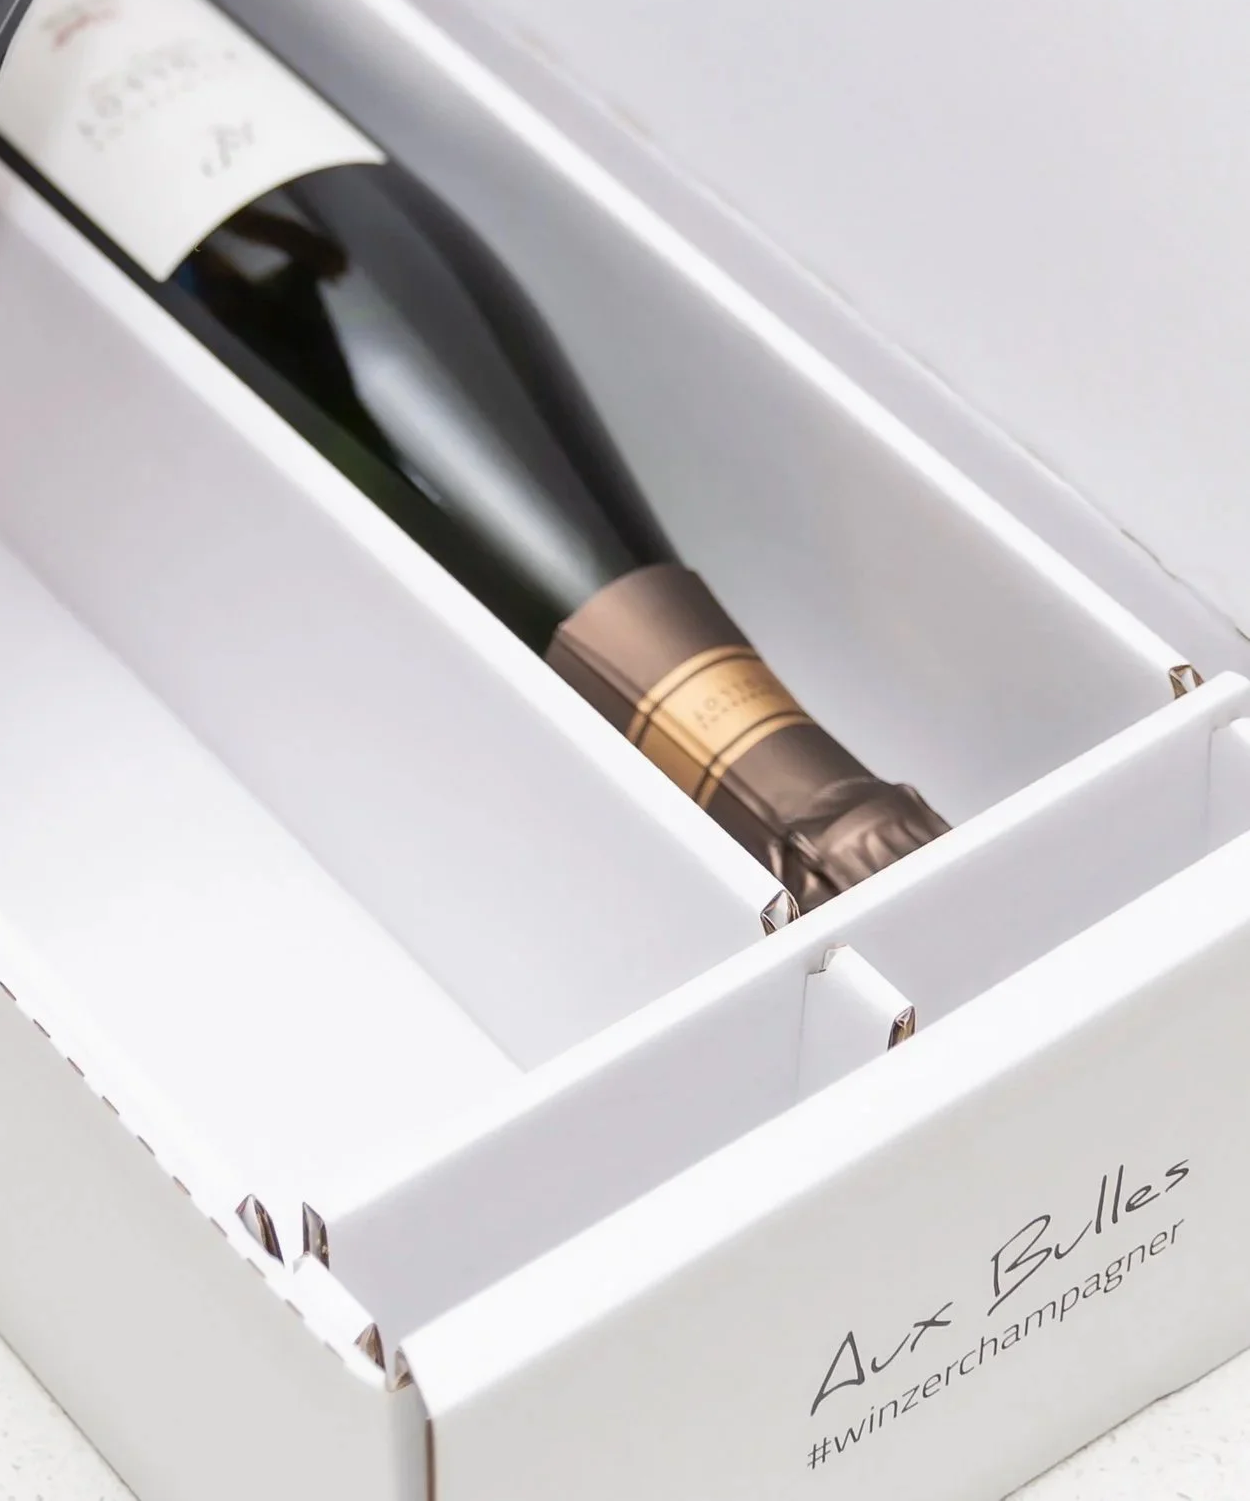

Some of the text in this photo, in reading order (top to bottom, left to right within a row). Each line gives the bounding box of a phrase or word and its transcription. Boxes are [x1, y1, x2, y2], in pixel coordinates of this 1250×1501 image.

[807, 1218, 1185, 1470] #winzerchampagner
[810, 1158, 1190, 1417] Aux Bulles
